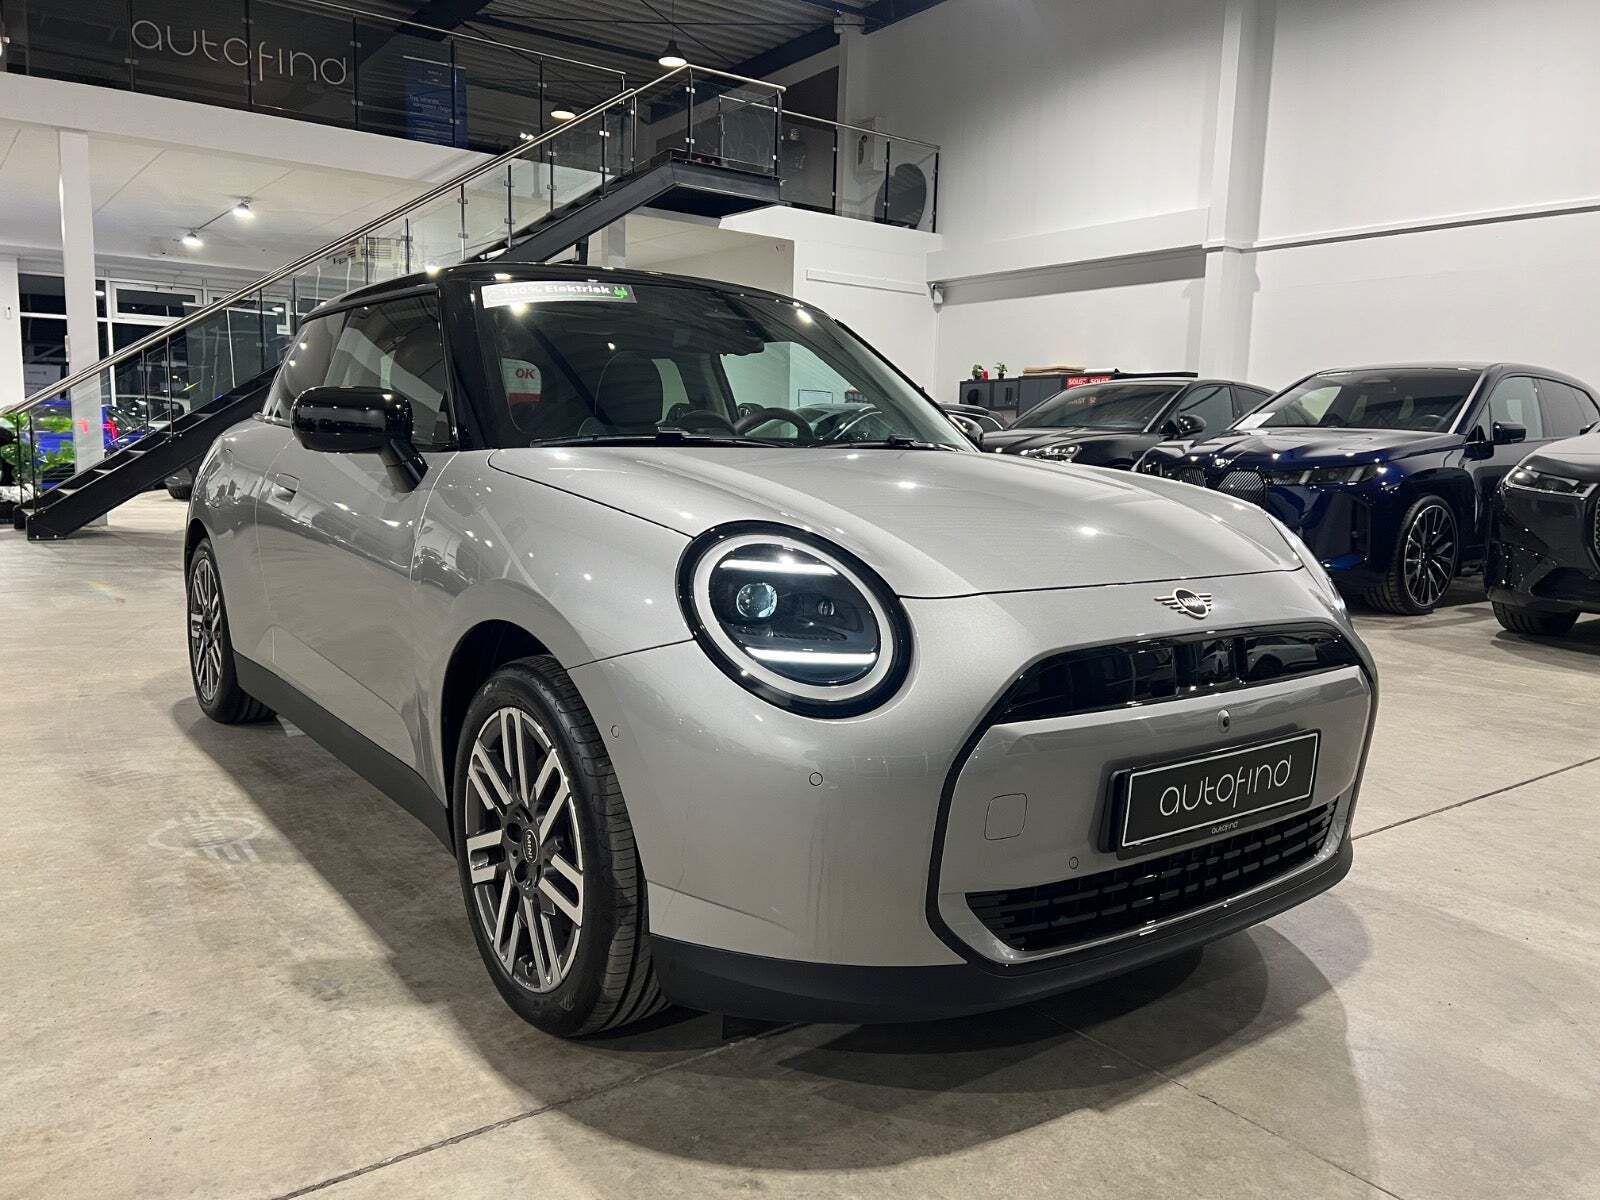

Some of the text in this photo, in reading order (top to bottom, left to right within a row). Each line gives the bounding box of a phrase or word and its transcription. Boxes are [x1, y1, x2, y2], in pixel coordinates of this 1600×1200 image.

[132, 20, 347, 85] autofind
[515, 368, 535, 379] OK
[1160, 754, 1292, 816] autofind
